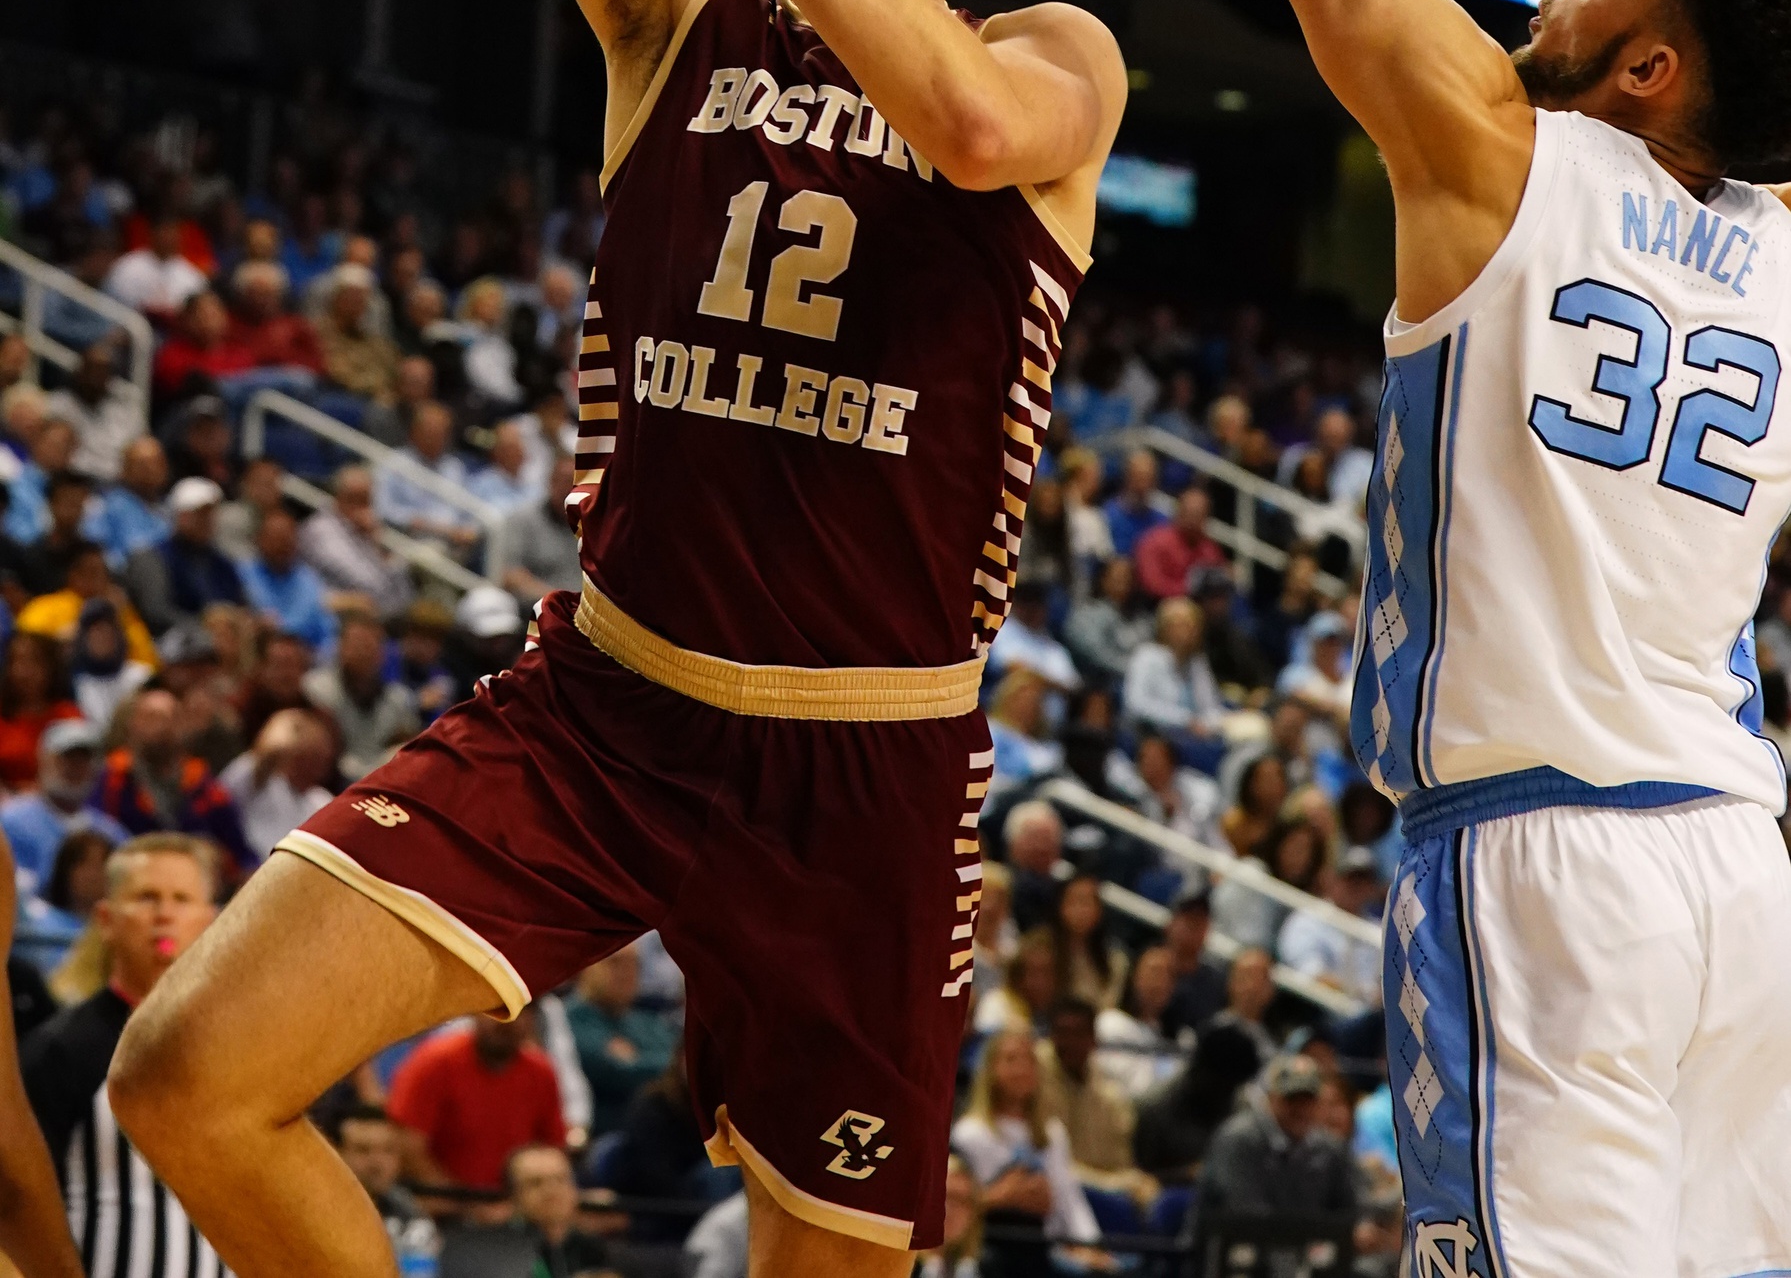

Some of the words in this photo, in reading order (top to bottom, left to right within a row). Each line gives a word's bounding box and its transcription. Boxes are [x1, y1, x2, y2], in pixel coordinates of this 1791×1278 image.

[697, 181, 858, 341] 12
[1621, 191, 1760, 298] NANCE
[634, 335, 919, 456] COLLEGE
[1528, 278, 1782, 516] 32
